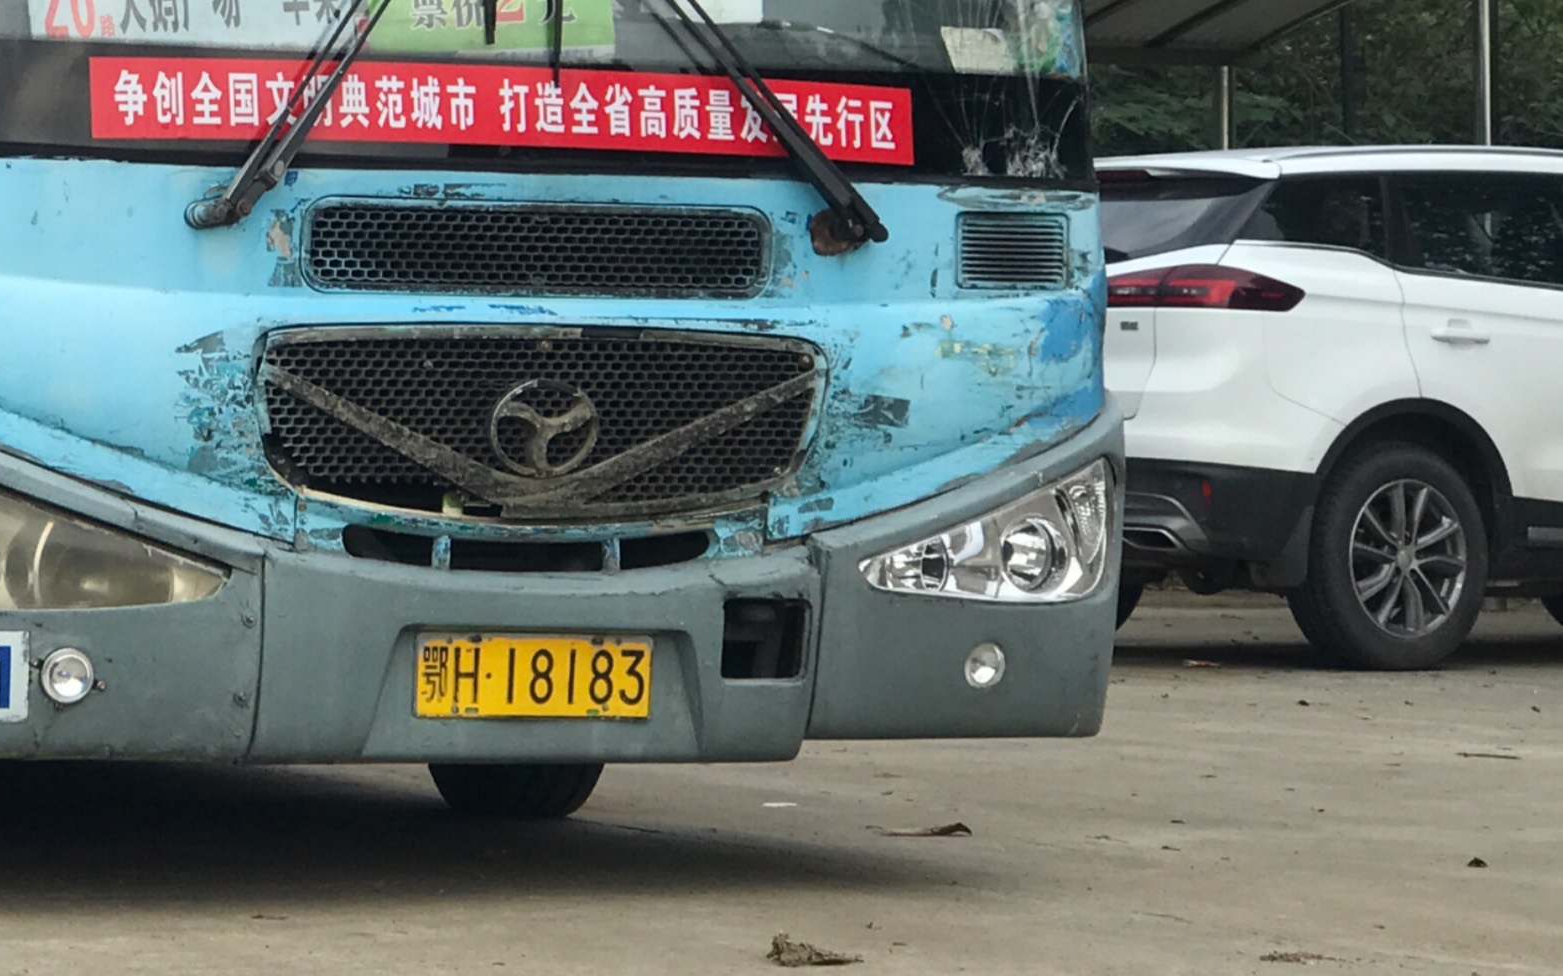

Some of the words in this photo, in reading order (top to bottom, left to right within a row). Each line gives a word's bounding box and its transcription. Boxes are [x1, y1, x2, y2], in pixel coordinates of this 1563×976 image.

[113, 69, 477, 130] 争创全国文明典范城市
